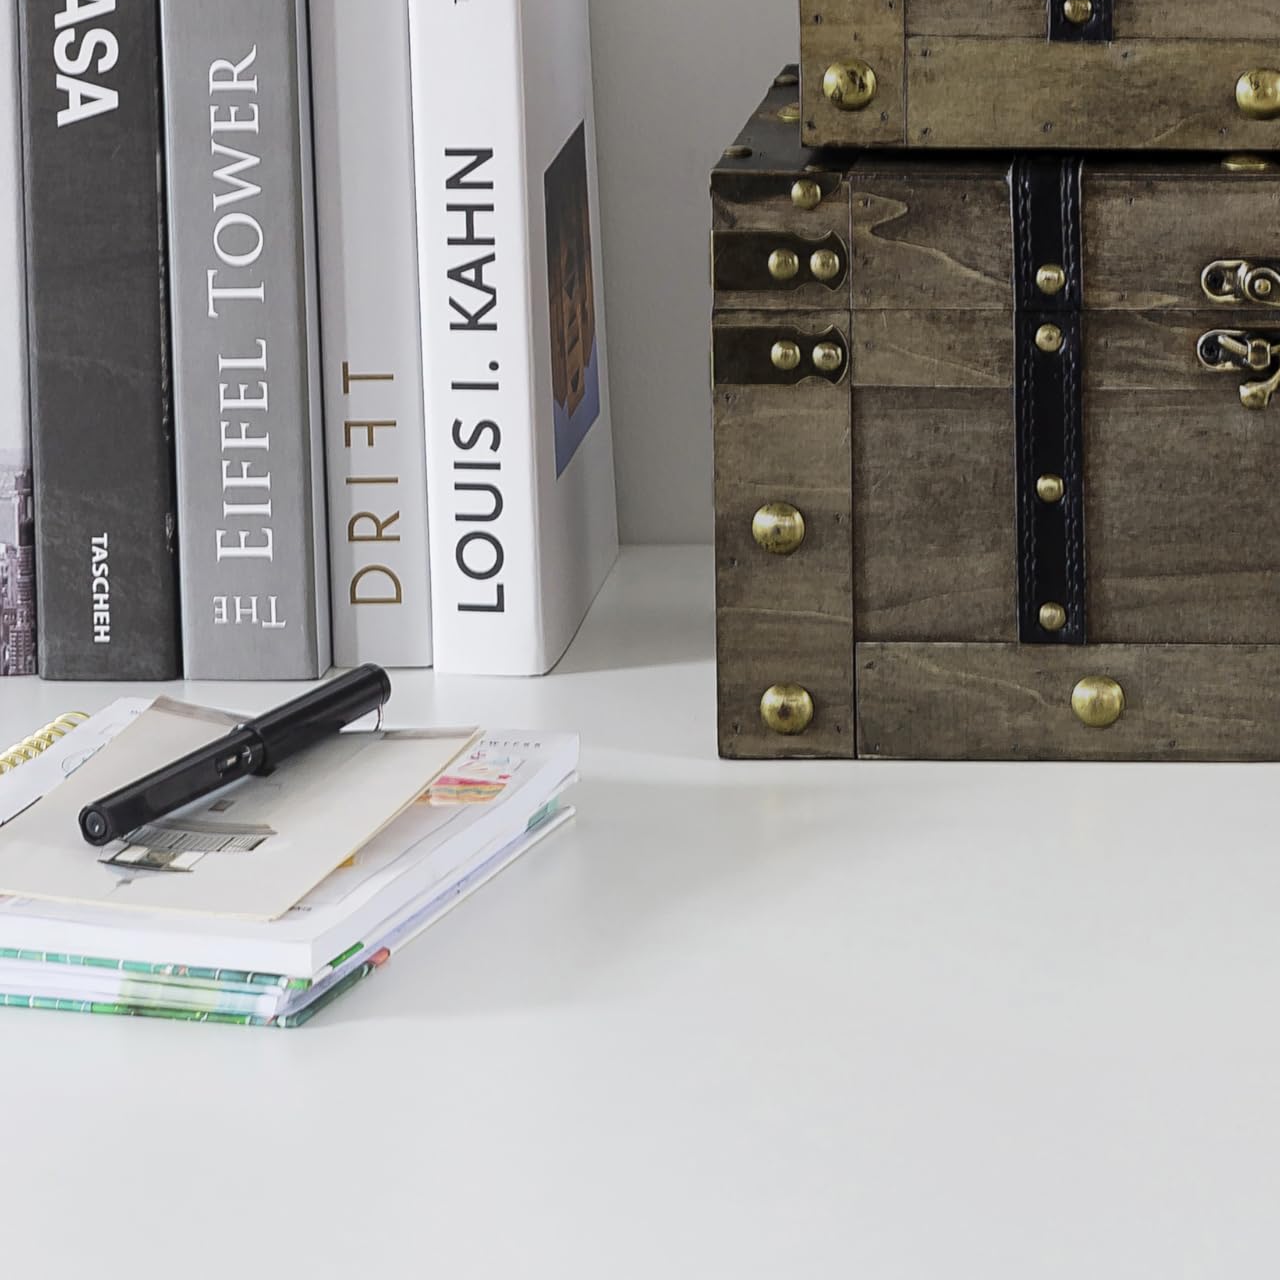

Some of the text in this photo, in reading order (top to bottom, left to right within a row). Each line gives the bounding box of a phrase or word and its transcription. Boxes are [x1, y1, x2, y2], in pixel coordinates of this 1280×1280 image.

[207, 44, 265, 319] TOWER
[215, 339, 273, 563] EIFFEL
[341, 361, 402, 605] DRIFT
[444, 148, 505, 613] LOUIS I. KAHN
